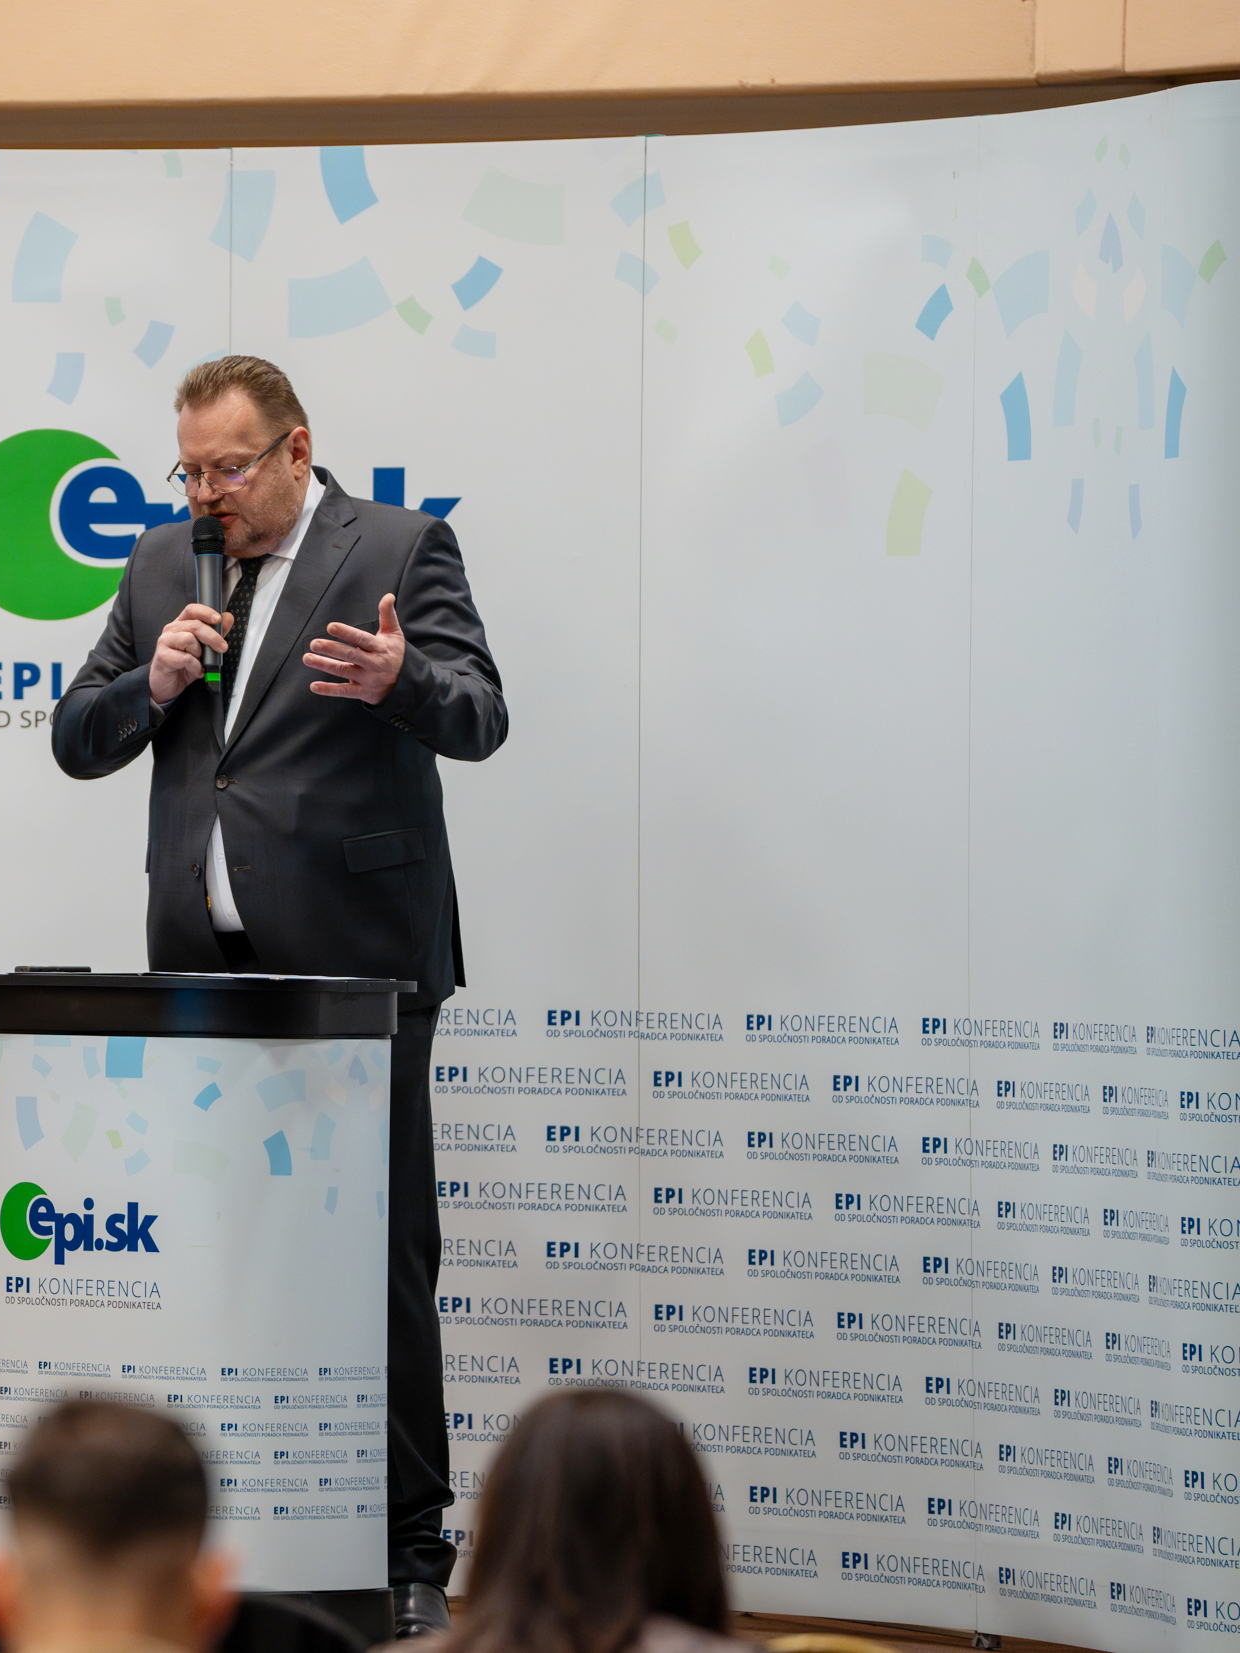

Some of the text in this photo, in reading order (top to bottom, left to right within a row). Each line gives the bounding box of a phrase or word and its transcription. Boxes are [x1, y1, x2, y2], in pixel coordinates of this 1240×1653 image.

[547, 1009, 723, 1030] EPI KONFERENCIA
[746, 1014, 899, 1033] EPI KONFERENCIA
[922, 1017, 1040, 1038] EPI KONFERENCIA
[546, 1028, 724, 1042] OD SPOLOČNOSTI PORADCA PODNIKATEĽA
[746, 1033, 899, 1045] OD SPOLOČNOSTI PORADCA PODNIKATEĽA
[436, 1066, 626, 1085] EPI KONFERENCIA
[653, 1070, 809, 1090] EPI KONFERENCIA
[833, 1075, 979, 1096] EPI KONFERENCIA
[435, 1084, 627, 1096] OD SPOLOČNOSTI PORADCA PODNIKATEĽA
[997, 1080, 1090, 1101] EPI KONFERENCIA
[1180, 1091, 1199, 1109] EPI
[832, 1094, 980, 1109] OD SPOLOČNOSTI PORADCA PODNIKATEĽA
[546, 1125, 723, 1147] EPI KONFERENCIA
[747, 1131, 898, 1152] EPI KONFERENCIA
[922, 1137, 1039, 1159] EPI KONFERENCIA
[439, 1181, 627, 1201] EPI KONFERENCIA
[654, 1187, 812, 1208] EPI KONFERENCIA
[653, 1207, 813, 1220] OD SPOLOČNOSTI PORADCA PODNIKATEĽA
[997, 1201, 1090, 1224] EPI KONFERENCIA
[29, 1197, 160, 1265] epi.sk
[546, 1241, 724, 1264] EPI KONFERENCIA
[545, 1261, 724, 1276] OD SPOLOČNOSTI PORADCA PODNIKATEĽA
[1052, 1266, 1139, 1290] EPI KONFERENCIA
[6, 1276, 161, 1299] EPI KONFERENCIA
[5, 1296, 162, 1310] OD SPOLOČNOSTI PORADCA PODNIKATEĽA
[440, 1297, 627, 1317] EPI KONFERENCIA
[654, 1304, 814, 1327] EPI KONFERENCIA
[837, 1312, 981, 1336] EPI KONFERENCIA
[38, 1361, 111, 1372] EPI KONFERENCIA
[121, 1365, 207, 1376] EPI KONFERENCIA
[221, 1367, 308, 1376] EPI KONFERENCIA
[318, 1366, 380, 1376] EPI KONFERENCIA
[549, 1357, 724, 1381] EPI KONFERENCIA
[749, 1367, 902, 1391] EPI KONFERENCIA
[0, 1387, 11, 1395] EPI
[167, 1394, 261, 1405] EPI KONFERENCIA
[274, 1395, 348, 1404] EPI KONFERENCIA
[748, 1387, 903, 1403] OD SPOLOČNOSTI PORADCA PODNIKATEĽA
[220, 1423, 308, 1432] EPI KONFERENCIA
[319, 1421, 380, 1431] EPI KONFERENCIA
[274, 1450, 348, 1459] EPI KONFERENCIA
[839, 1431, 983, 1458] EPI KONFERENCIA
[839, 1452, 983, 1471] OD SPOLOČNOSTI PORADCA PODNIKATEĽA
[999, 1444, 1094, 1471] EPI KONFERENCIA
[220, 1478, 308, 1487] EPI KONFERENCIA
[274, 1506, 348, 1515] EPI KONFERENCIA
[1054, 1512, 1143, 1540] EPI KONFERENCIA
[841, 1551, 985, 1580] EPI KONFERENCIA
[1187, 1598, 1207, 1618] EPI
